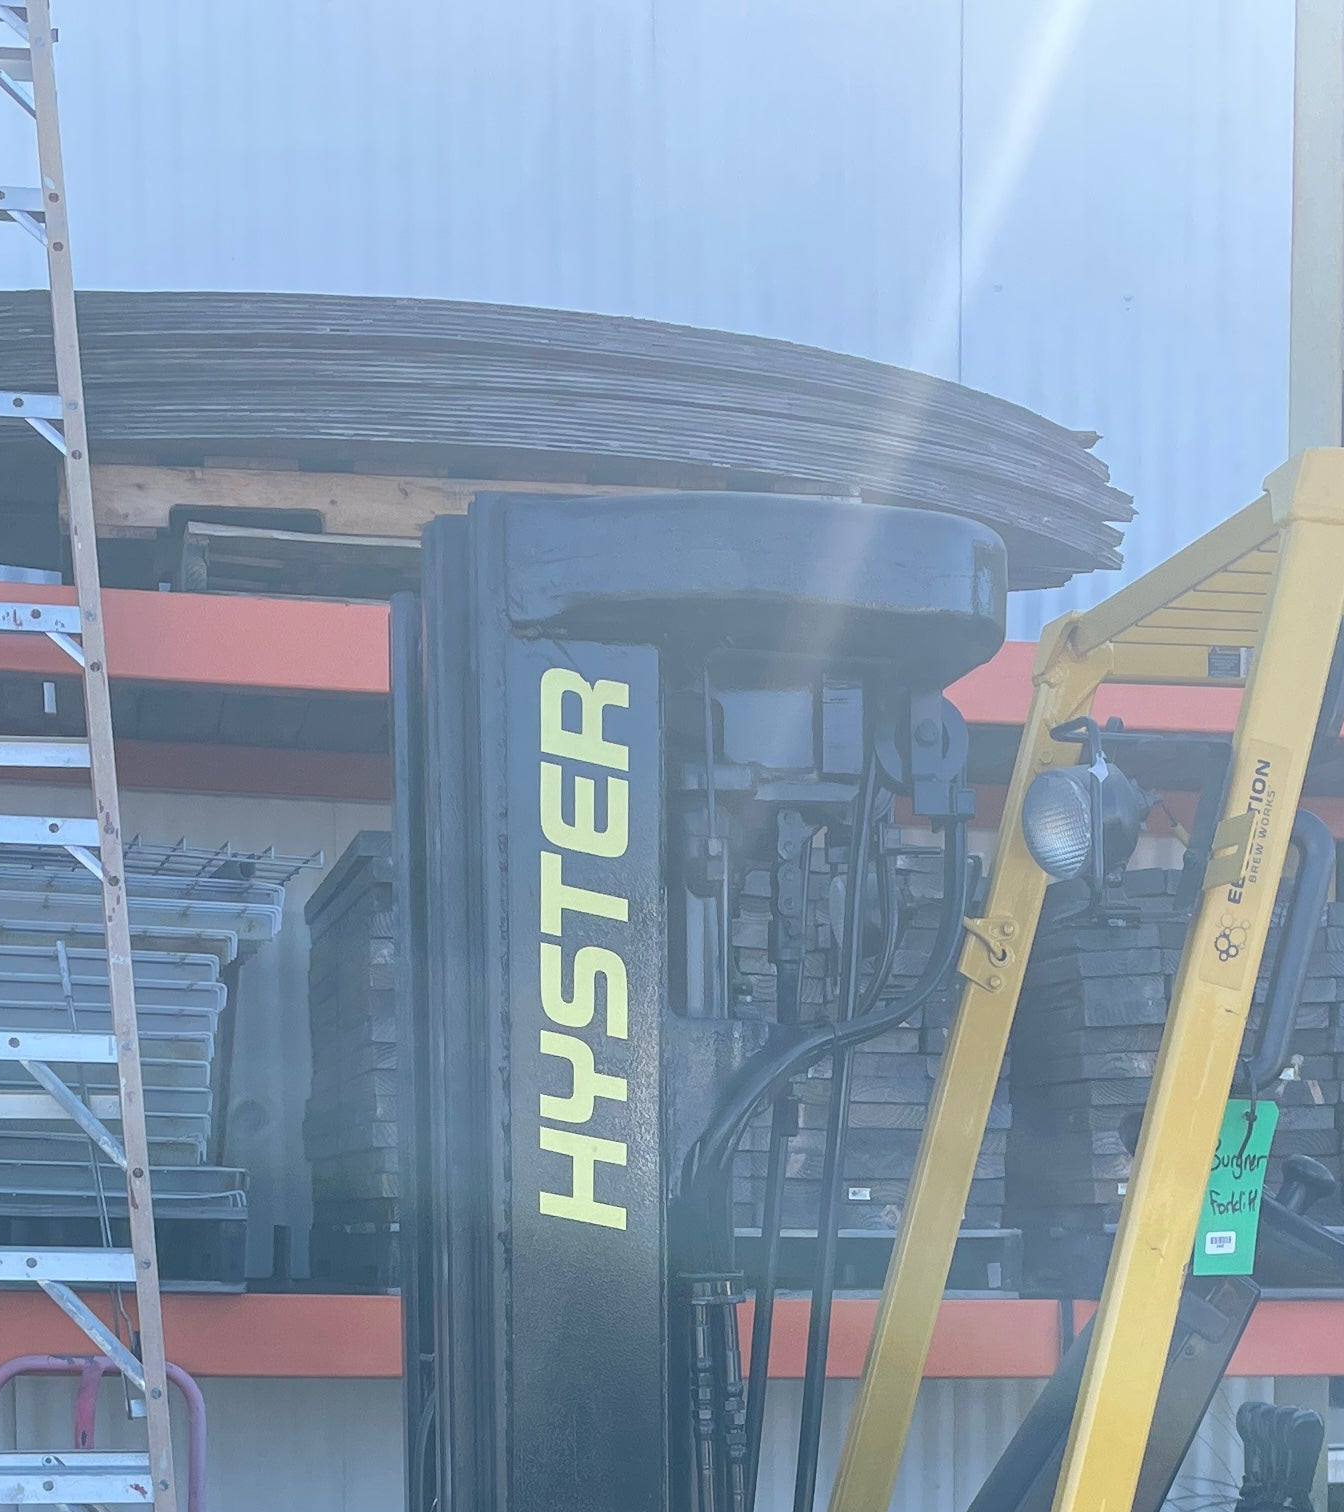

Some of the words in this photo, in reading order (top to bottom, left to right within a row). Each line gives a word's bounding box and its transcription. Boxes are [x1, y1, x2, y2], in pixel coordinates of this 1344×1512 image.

[539, 666, 630, 1231] HYSTER
[1248, 843, 1264, 884] BREW
[1258, 789, 1276, 840] WORKS
